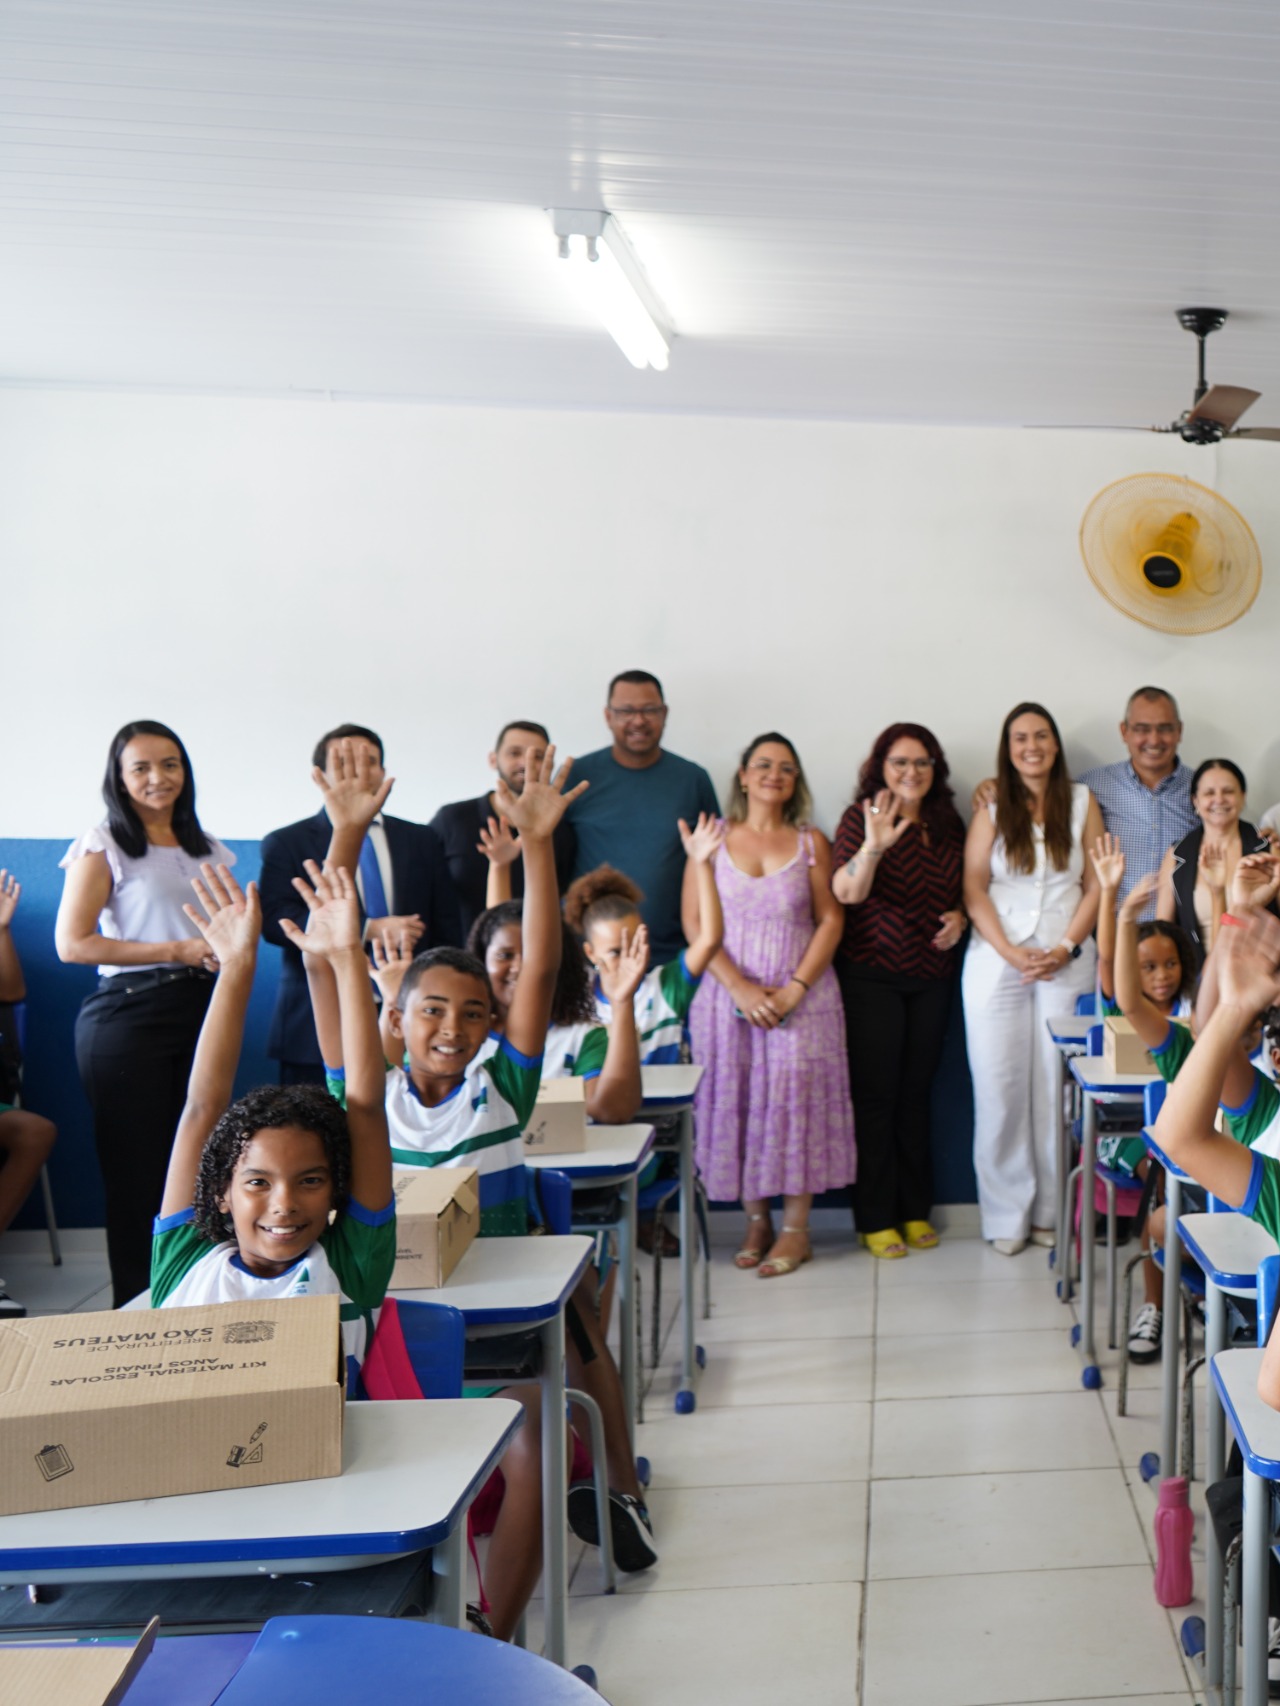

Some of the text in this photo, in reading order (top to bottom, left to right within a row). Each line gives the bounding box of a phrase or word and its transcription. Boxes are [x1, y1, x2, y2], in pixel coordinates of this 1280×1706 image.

[53, 1327, 214, 1349] SÃO MATEUS
[87, 1337, 212, 1353] PREFEITURA DE
[50, 1361, 267, 1387] KIT MATERIAL ESCOLAR
[104, 1357, 220, 1374] ANOS FINAIS
